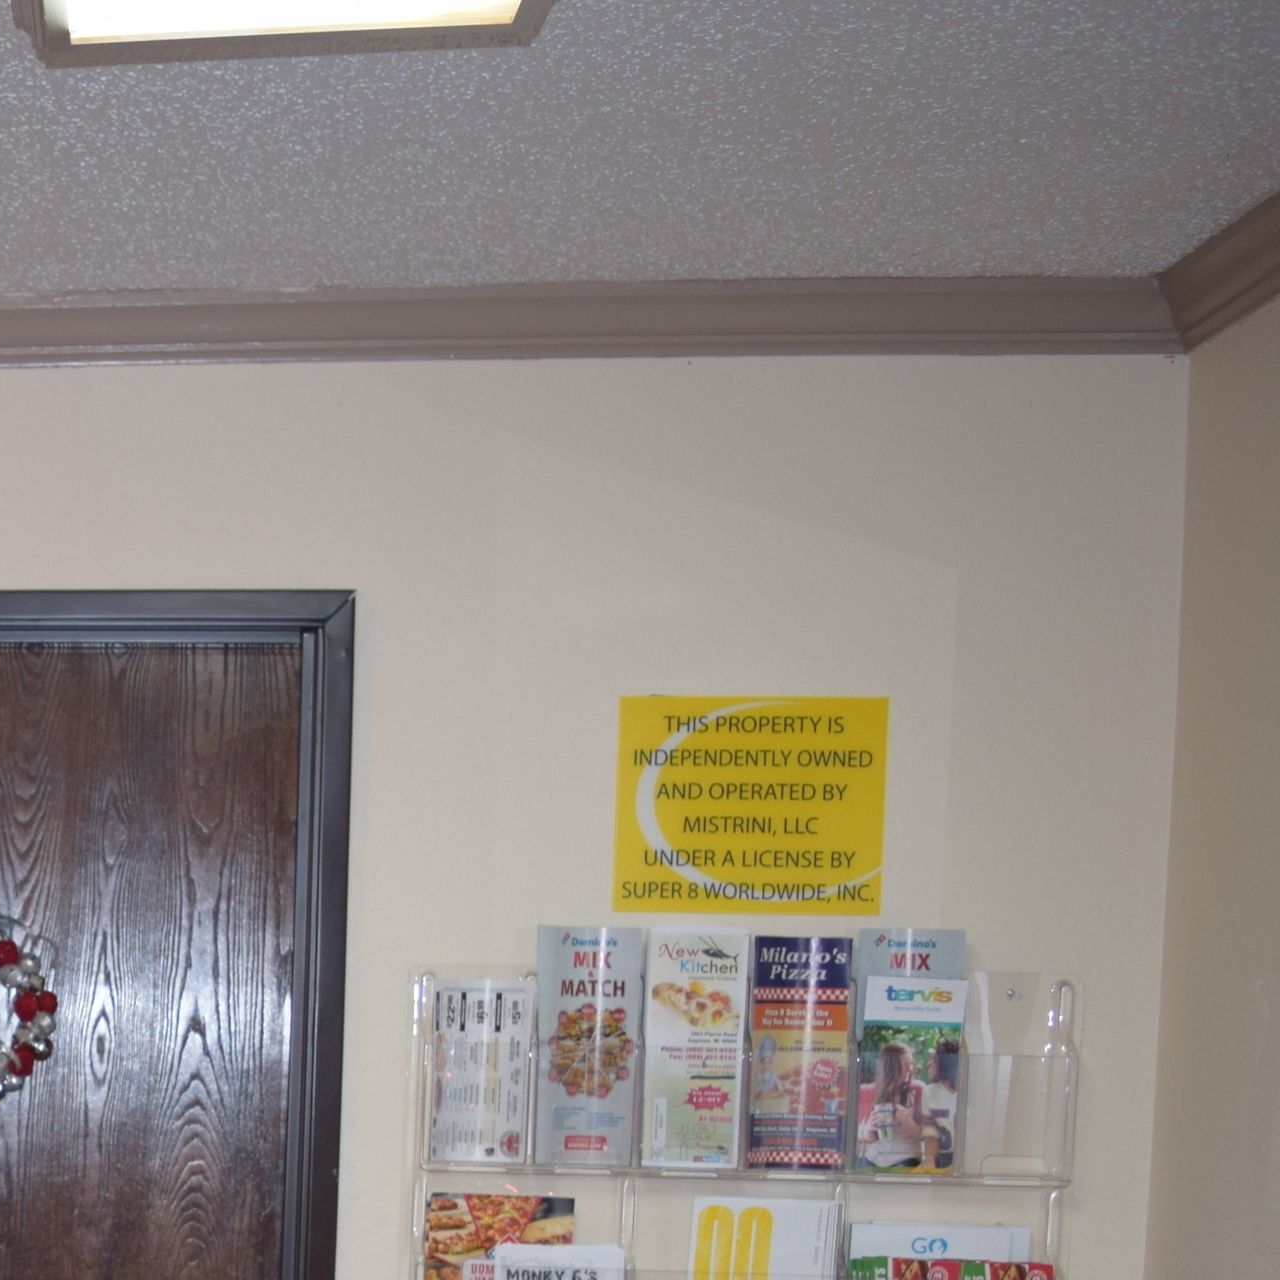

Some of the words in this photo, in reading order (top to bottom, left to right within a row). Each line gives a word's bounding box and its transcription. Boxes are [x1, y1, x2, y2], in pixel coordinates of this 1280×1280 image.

[664, 716, 708, 734] THIS
[715, 716, 822, 734] PROPERTY
[828, 716, 844, 734] IS
[633, 749, 791, 768] INDEPENDENTLY
[797, 749, 873, 768] OWNED
[656, 783, 703, 800] AND
[709, 783, 816, 801] OPERATED
[822, 783, 847, 801] BY
[683, 816, 777, 837] MISTRINI,
[783, 816, 819, 835] LLC
[644, 849, 715, 868] UNDER
[722, 850, 736, 868] A
[742, 849, 824, 868] LICENSE
[830, 850, 856, 869] BY
[621, 881, 681, 899] SUPER
[688, 882, 698, 899] 8
[704, 882, 831, 903] WORLDWIDE,
[837, 884, 875, 903] INC.
[658, 941, 700, 961] New
[760, 947, 847, 964] Milano's
[680, 959, 738, 974] Kitchen
[889, 951, 931, 971] MIX
[770, 965, 827, 980] Pizza
[560, 979, 626, 998] MATCH
[885, 985, 953, 1003] tervis
[785, 1008, 815, 1017] Servie
[784, 1018, 825, 1026] Remeber
